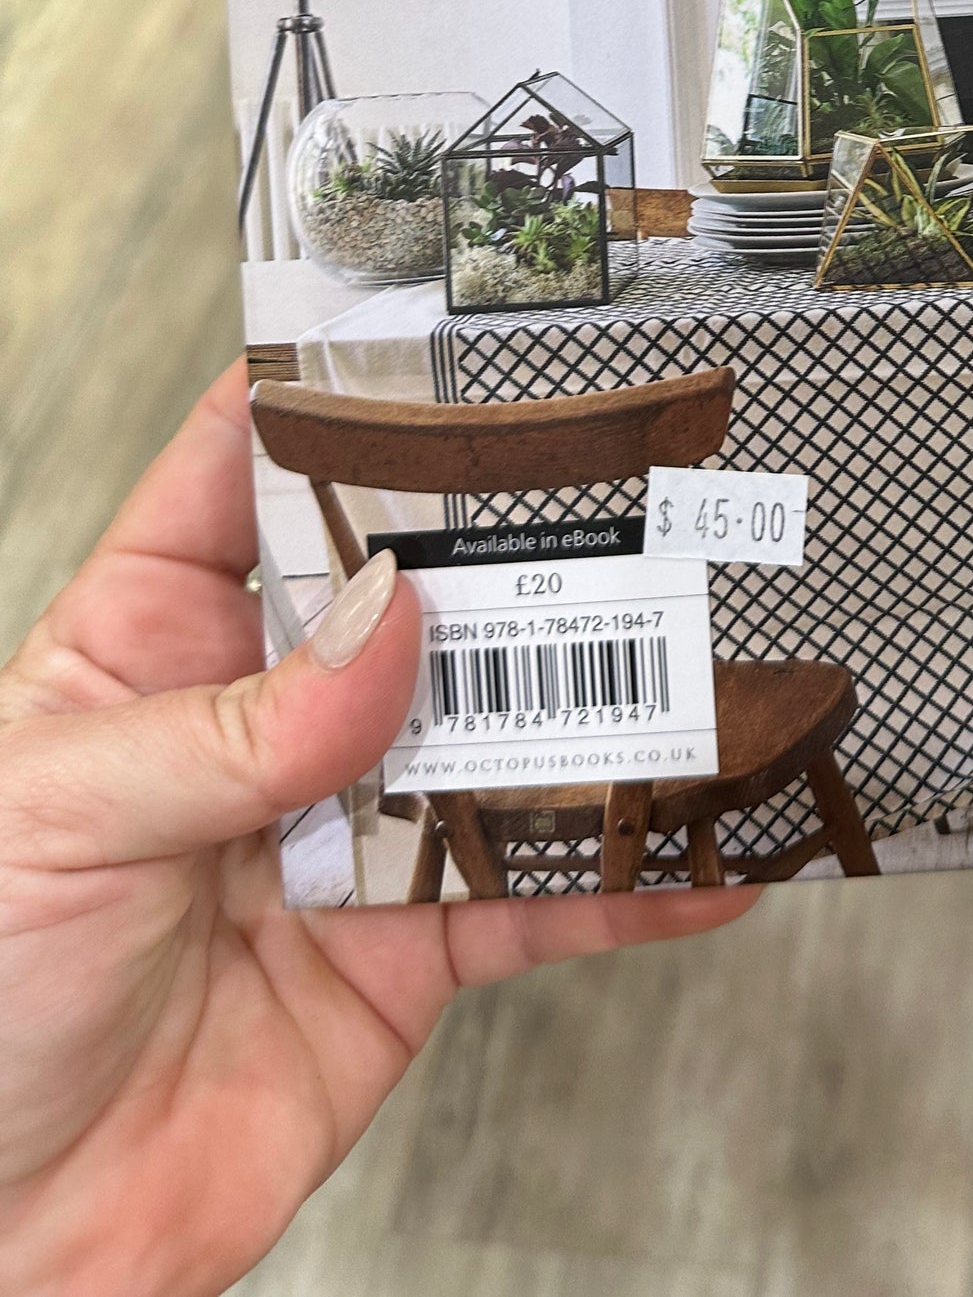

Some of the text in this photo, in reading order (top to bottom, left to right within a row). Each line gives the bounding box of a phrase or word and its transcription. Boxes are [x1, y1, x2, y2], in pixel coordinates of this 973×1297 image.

[453, 527, 621, 556] Available in eBook
[515, 572, 563, 596] £20
[429, 611, 664, 642] ISBN 978-1-78472-194-7
[409, 703, 657, 735] 9 781784 721947
[404, 746, 697, 776] WWW.OCTOPUSBOOKS.CO.UK
